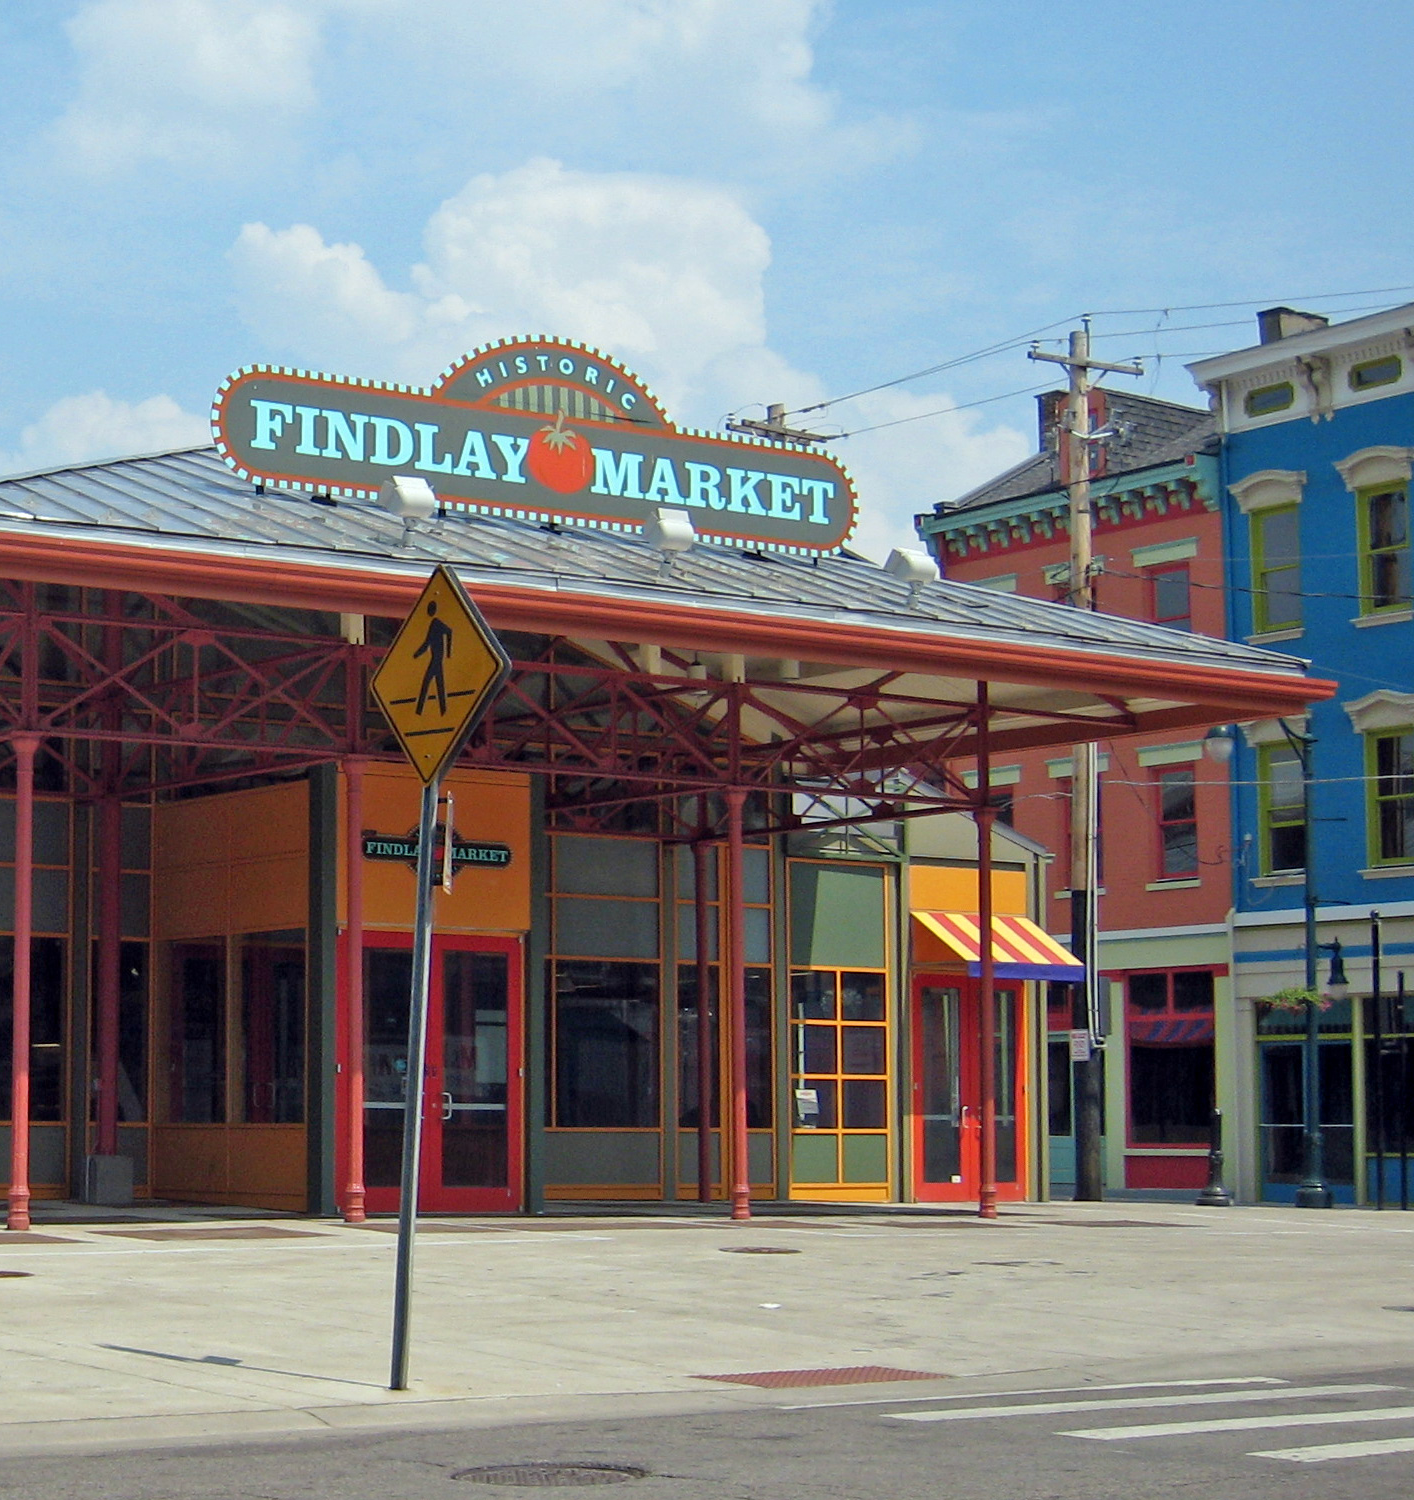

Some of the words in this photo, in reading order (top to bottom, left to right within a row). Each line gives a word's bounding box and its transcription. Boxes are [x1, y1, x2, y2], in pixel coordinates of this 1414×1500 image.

[475, 355, 636, 410] HISTORIC
[250, 399, 531, 484] FINDLAY
[590, 447, 834, 525] MARKET
[366, 841, 421, 857] FINDLA
